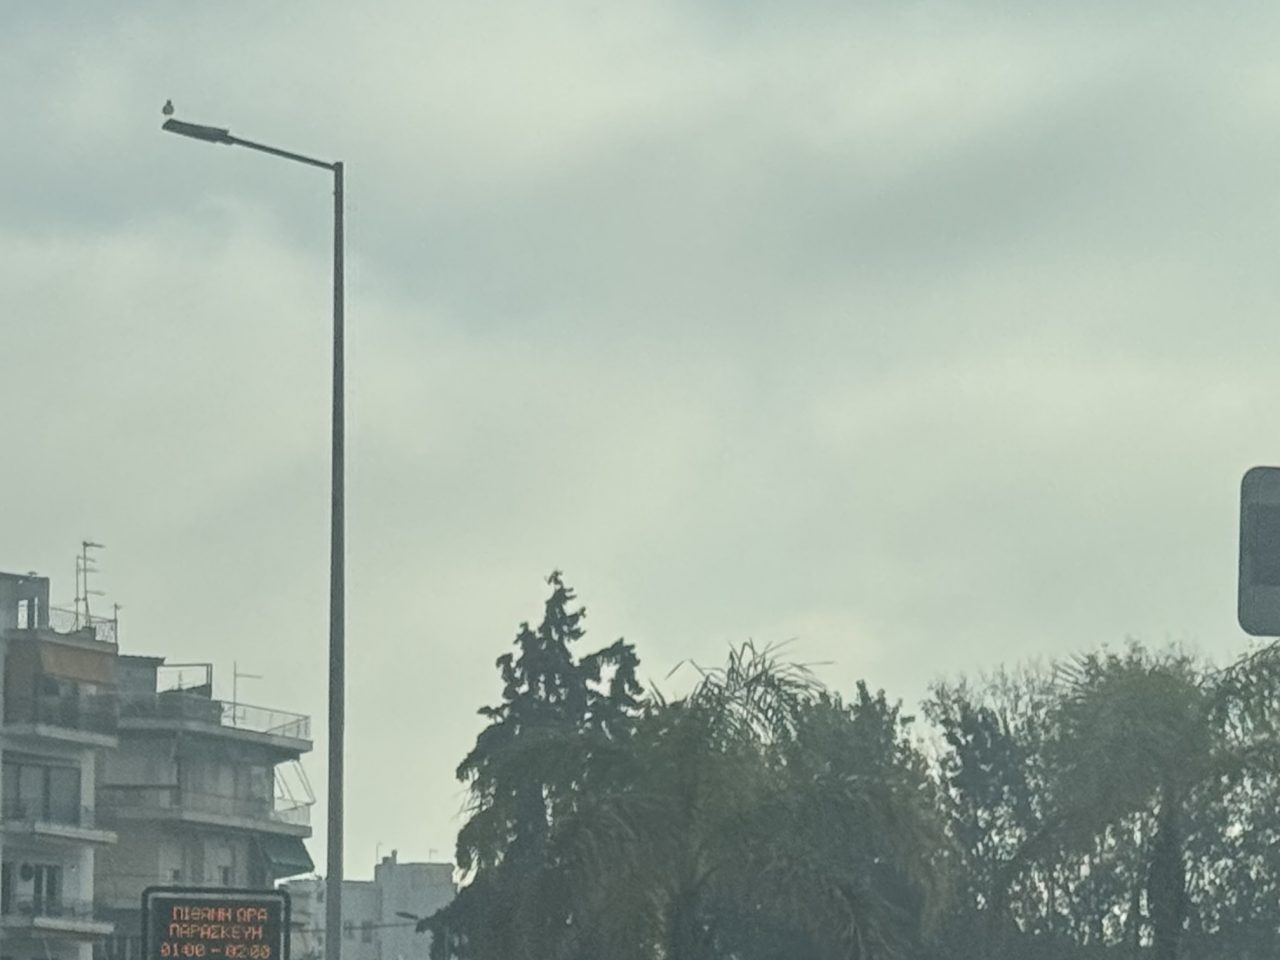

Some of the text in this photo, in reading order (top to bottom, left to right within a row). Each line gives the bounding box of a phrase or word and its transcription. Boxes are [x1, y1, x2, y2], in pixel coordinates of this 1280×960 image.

[172, 905, 269, 923] ΠΙΘΑΝΗ ΩΡΑ
[169, 922, 264, 940] ΠΑΡΑΣΚΕΥΗ
